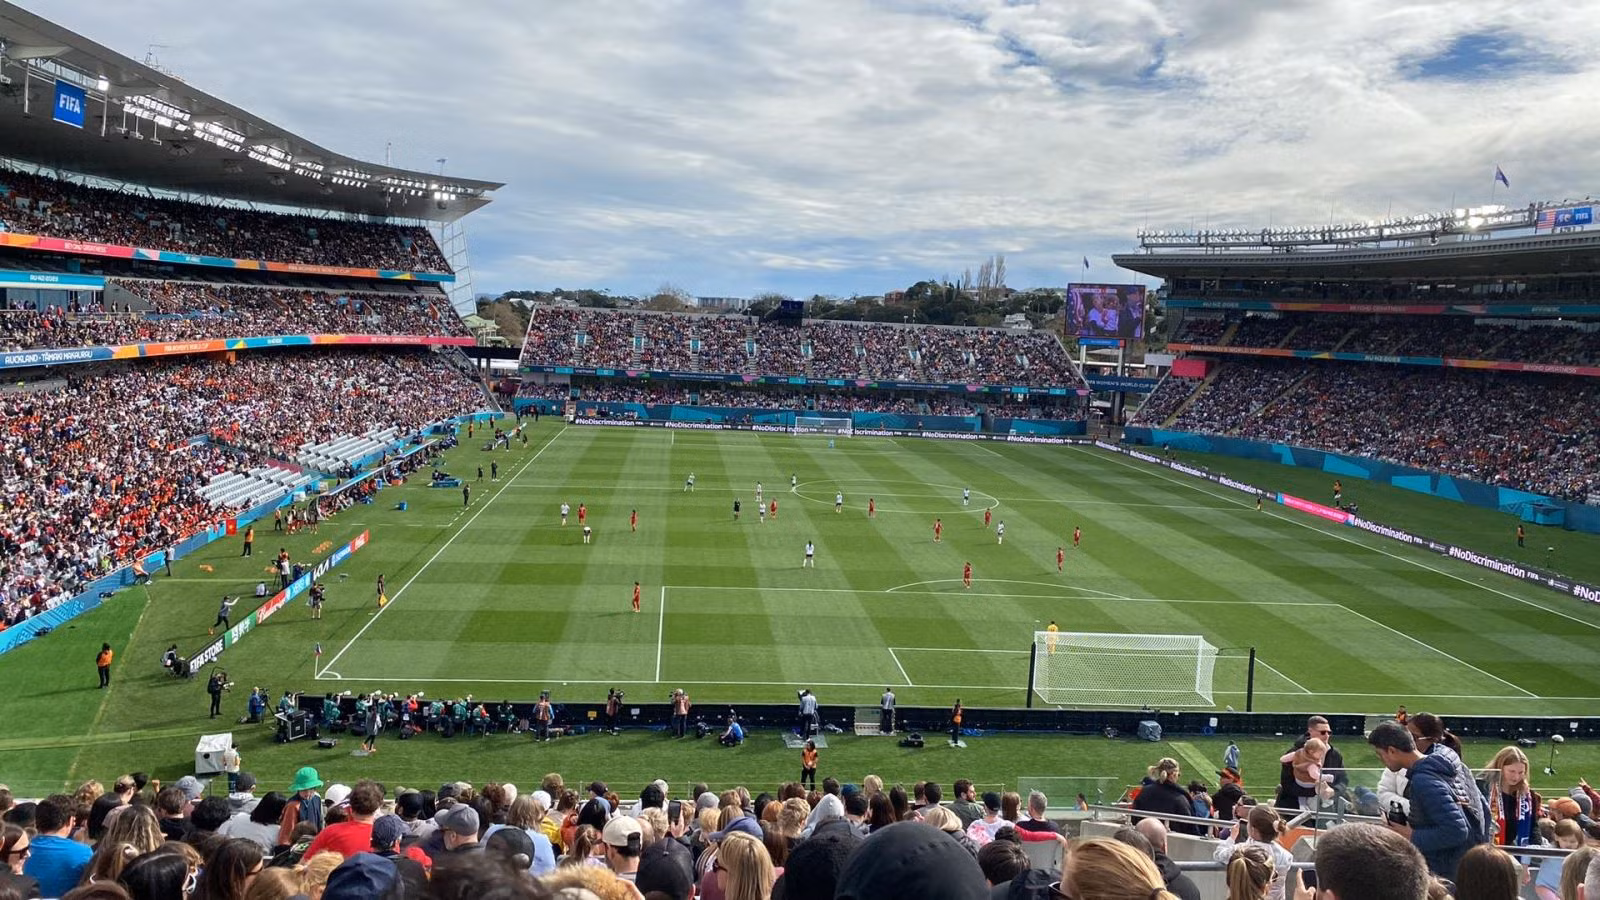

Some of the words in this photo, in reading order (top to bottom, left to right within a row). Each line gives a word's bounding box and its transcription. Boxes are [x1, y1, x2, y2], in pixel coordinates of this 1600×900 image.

[59, 93, 80, 114] FIFA
[5, 354, 38, 364] AUCKLAND
[575, 418, 634, 426] #NoDiscrimination
[665, 421, 722, 430] #NoDiscrimination
[922, 431, 978, 440] #NoDiscrimination
[1007, 436, 1064, 444] #NoDiscrimination
[1355, 517, 1413, 543] #NoDiscrimination
[1449, 546, 1525, 579] #NoDiscrimination
[1527, 571, 1539, 580] FIFA
[190, 653, 204, 670] FIFA
[204, 639, 224, 662] STORE
